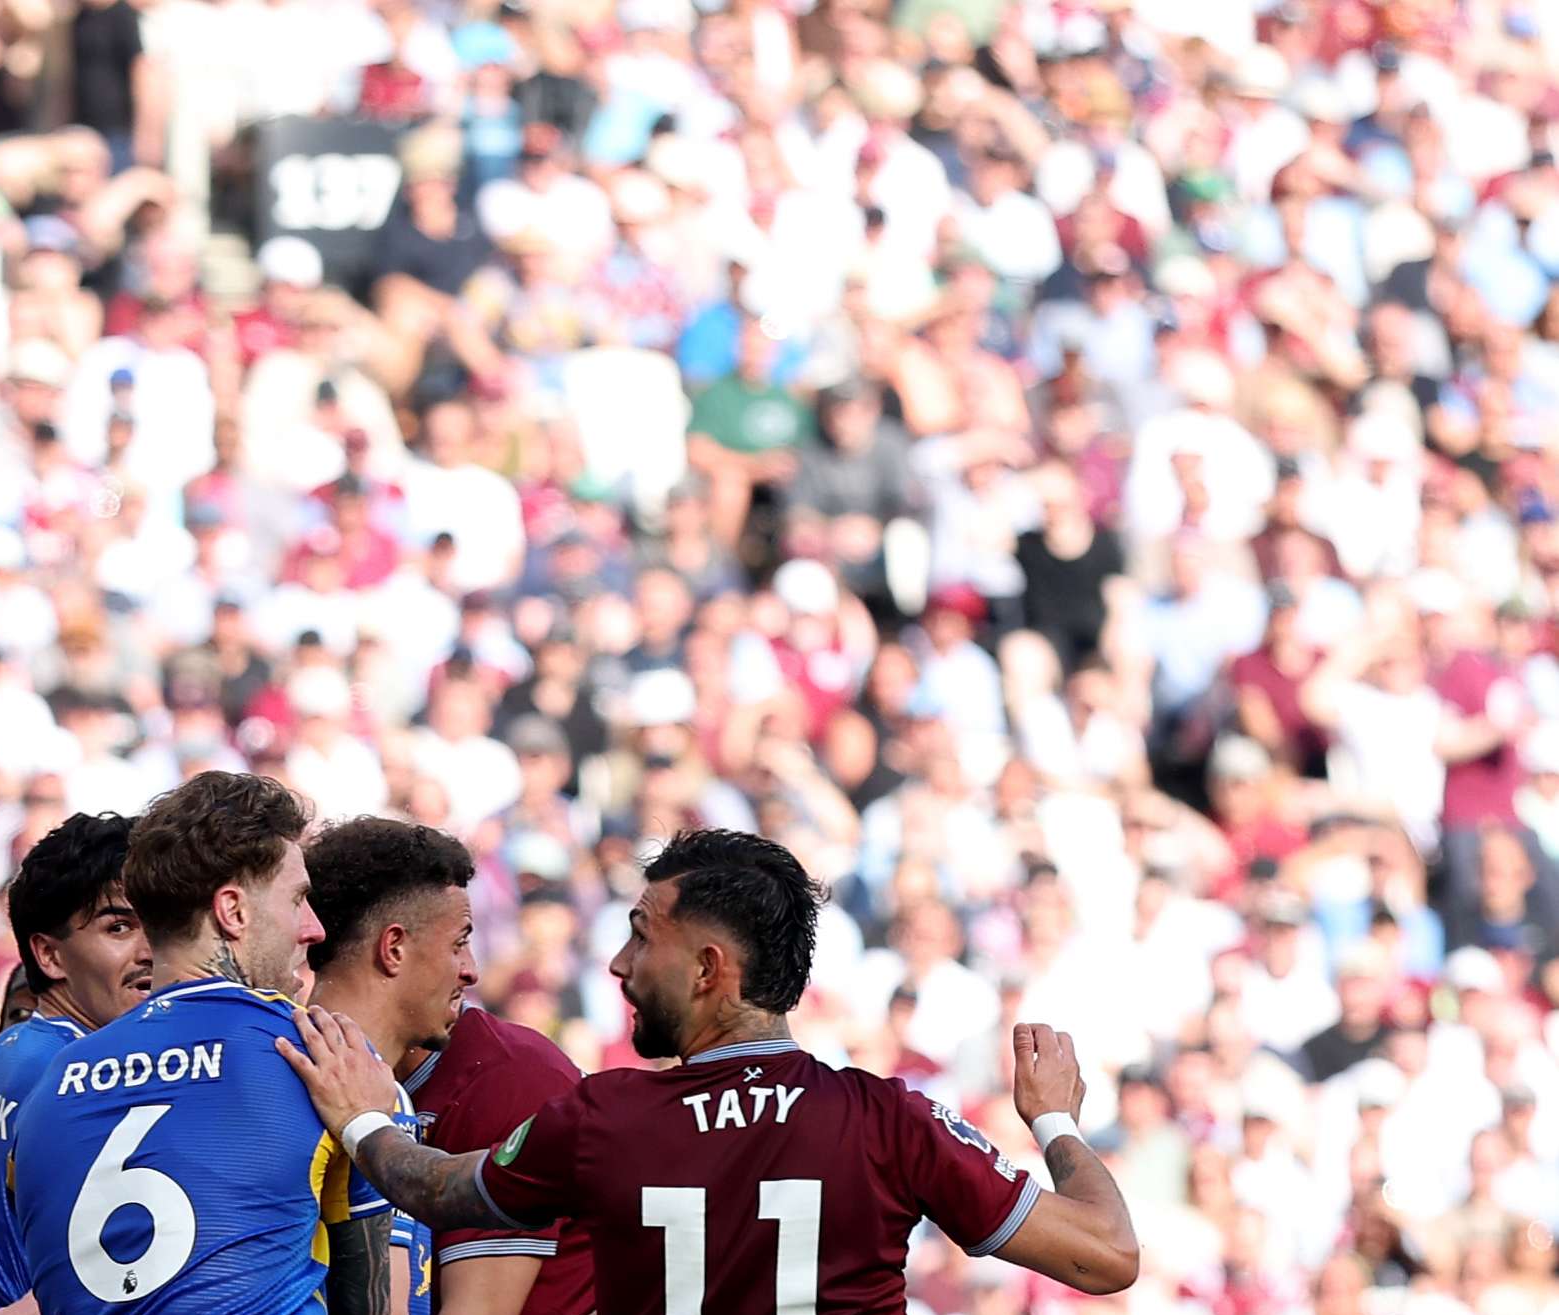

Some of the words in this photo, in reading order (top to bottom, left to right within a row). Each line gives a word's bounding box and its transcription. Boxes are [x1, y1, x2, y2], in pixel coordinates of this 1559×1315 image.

[57, 1043, 223, 1096] RODON
[682, 1083, 805, 1133] TATY
[68, 1104, 197, 1304] 6
